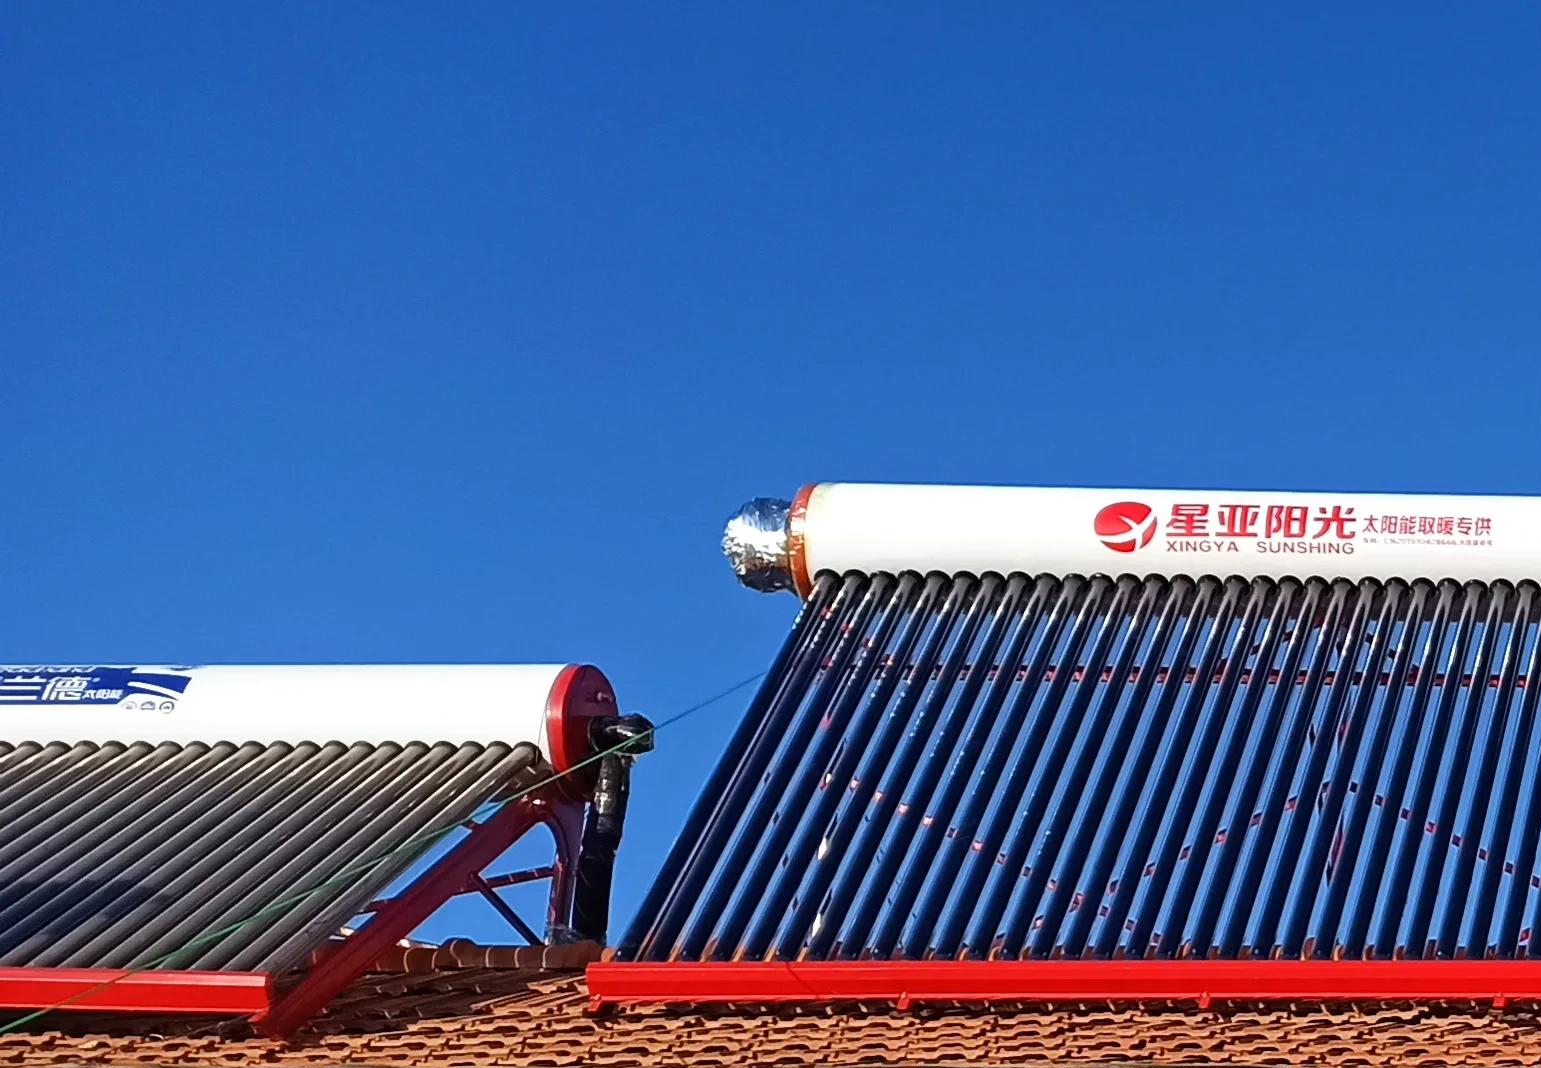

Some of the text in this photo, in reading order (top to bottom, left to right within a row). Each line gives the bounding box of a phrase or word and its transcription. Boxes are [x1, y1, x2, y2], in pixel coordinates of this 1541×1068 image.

[1165, 503, 1357, 539] 星亚阳光
[1362, 514, 1493, 536] 太阳能取暖专供
[1166, 540, 1239, 553] XINGYA
[1256, 541, 1355, 555] SUNSHING
